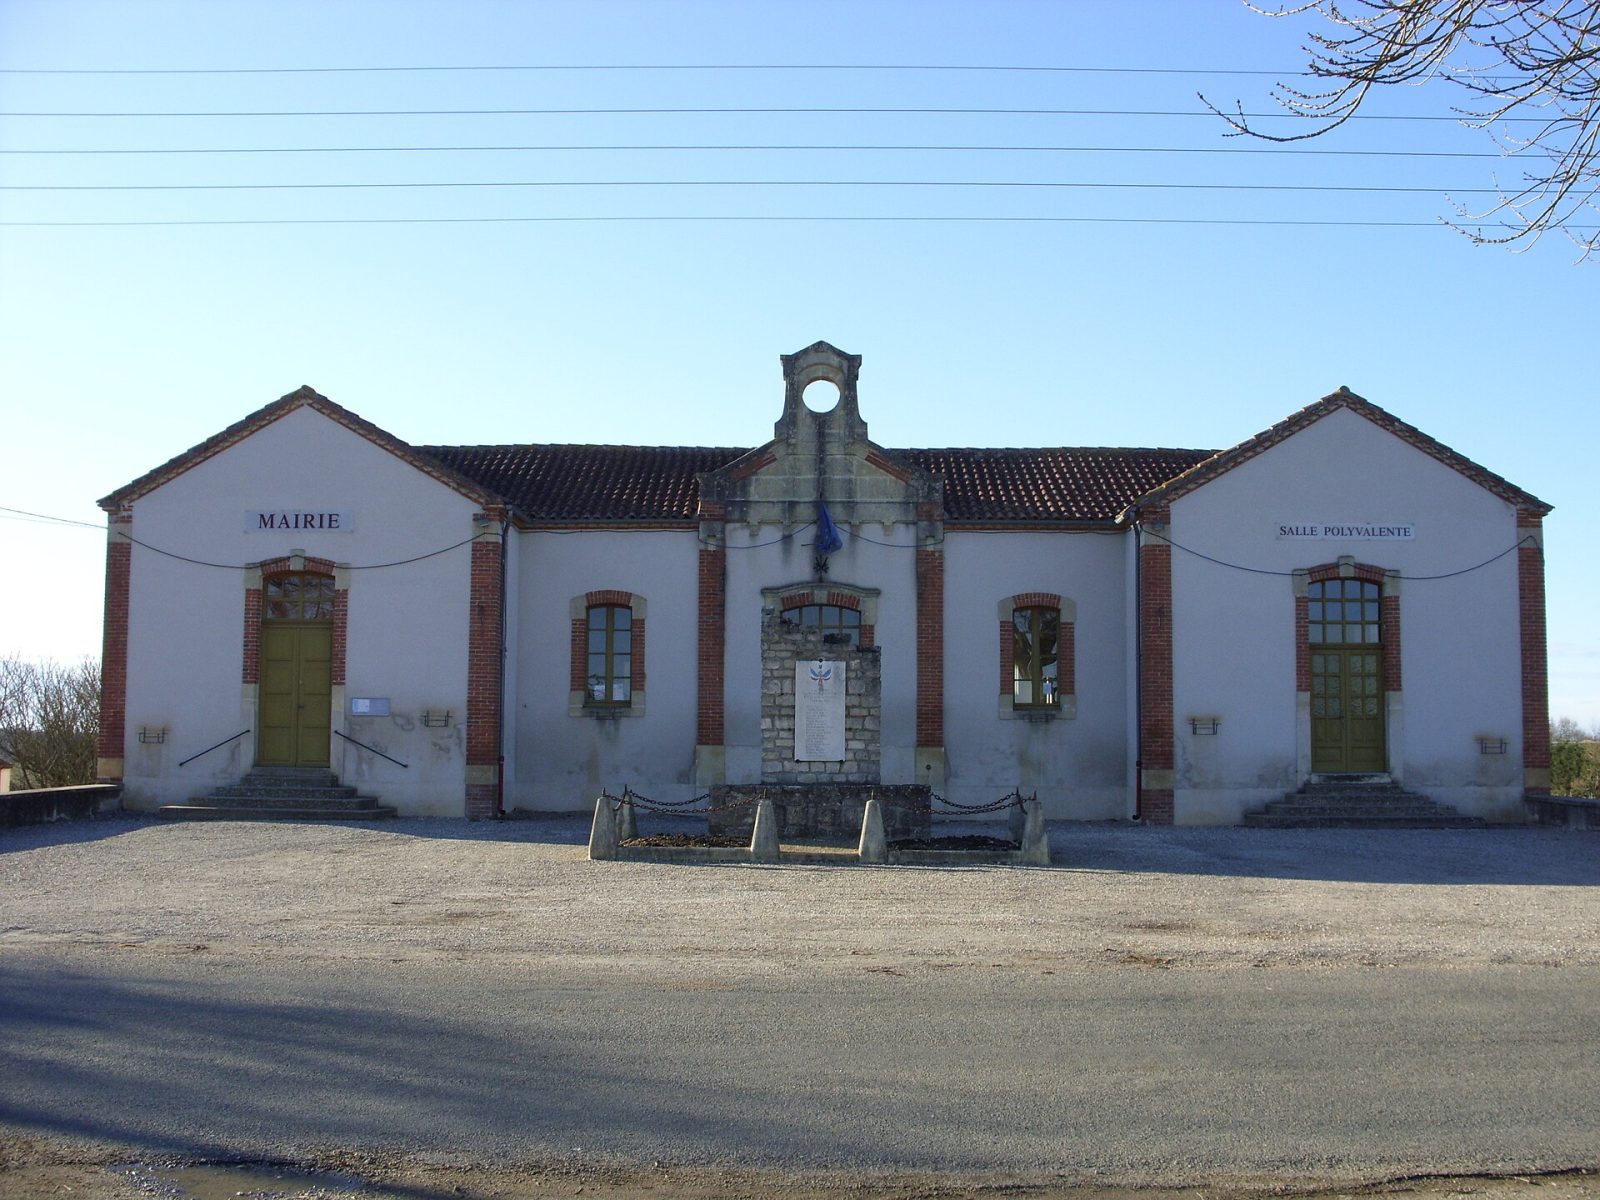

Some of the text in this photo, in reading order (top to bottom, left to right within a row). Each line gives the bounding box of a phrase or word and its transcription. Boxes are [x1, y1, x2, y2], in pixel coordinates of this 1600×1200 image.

[258, 513, 340, 529] MAIRIE
[1279, 526, 1411, 537] SALLE POLYVALENTE
